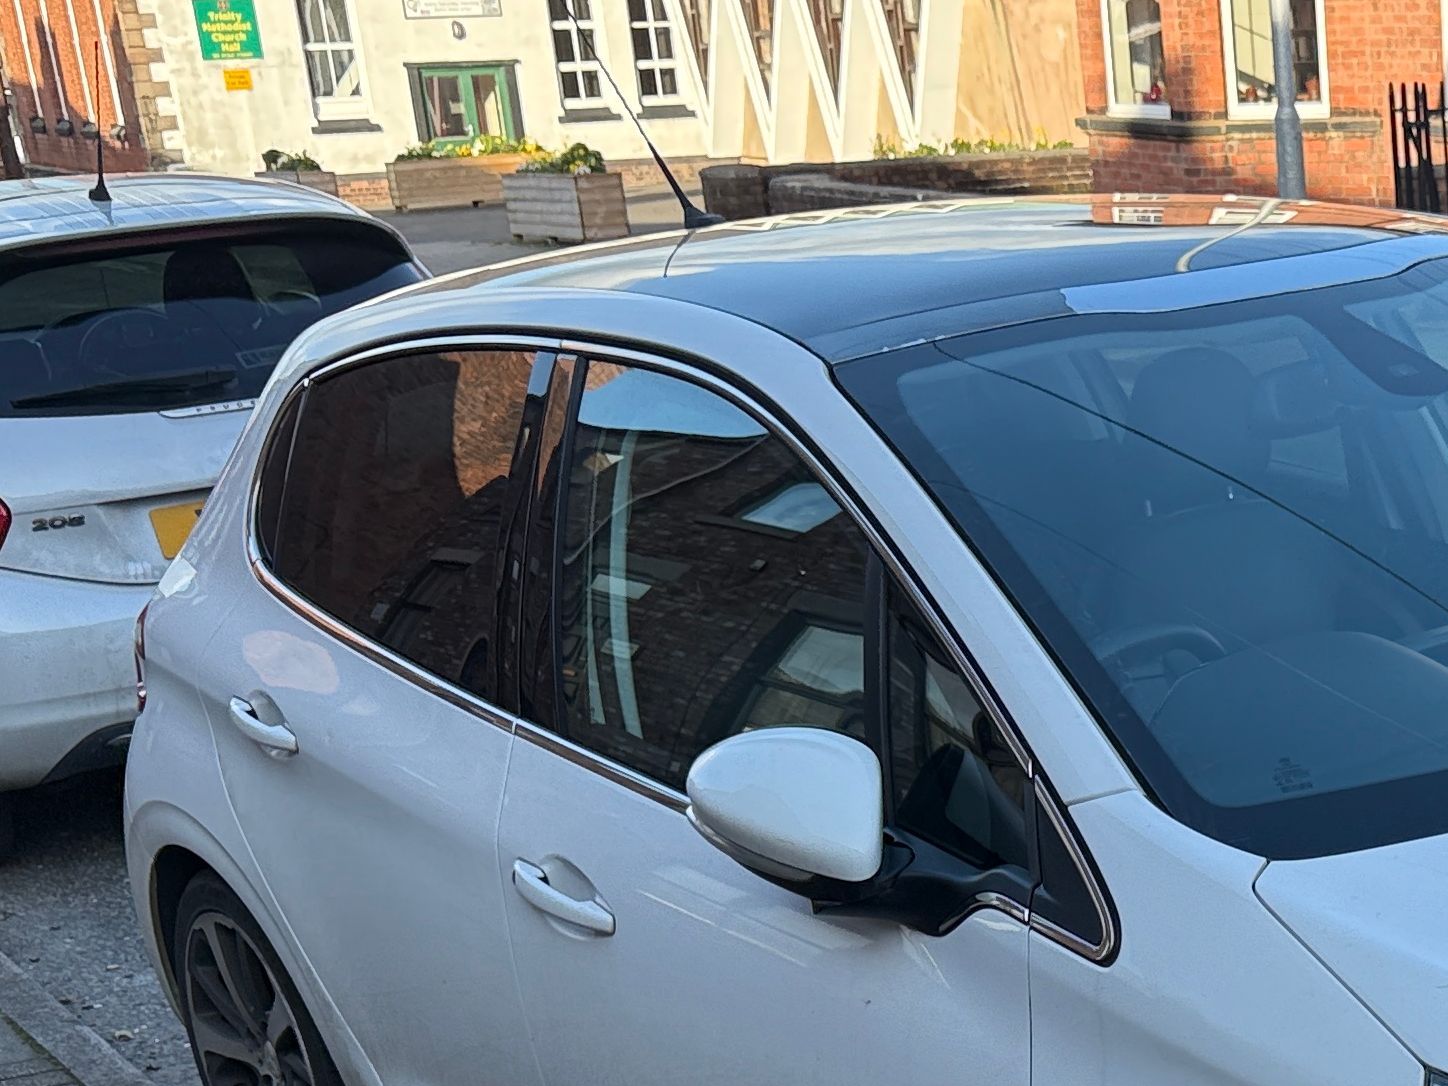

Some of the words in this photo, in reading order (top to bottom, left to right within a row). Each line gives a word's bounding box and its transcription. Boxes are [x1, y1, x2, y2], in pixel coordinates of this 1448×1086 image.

[207, 11, 242, 22] Trinity
[201, 22, 252, 32] Methodist
[211, 32, 247, 43] Church
[221, 42, 241, 52] Hall
